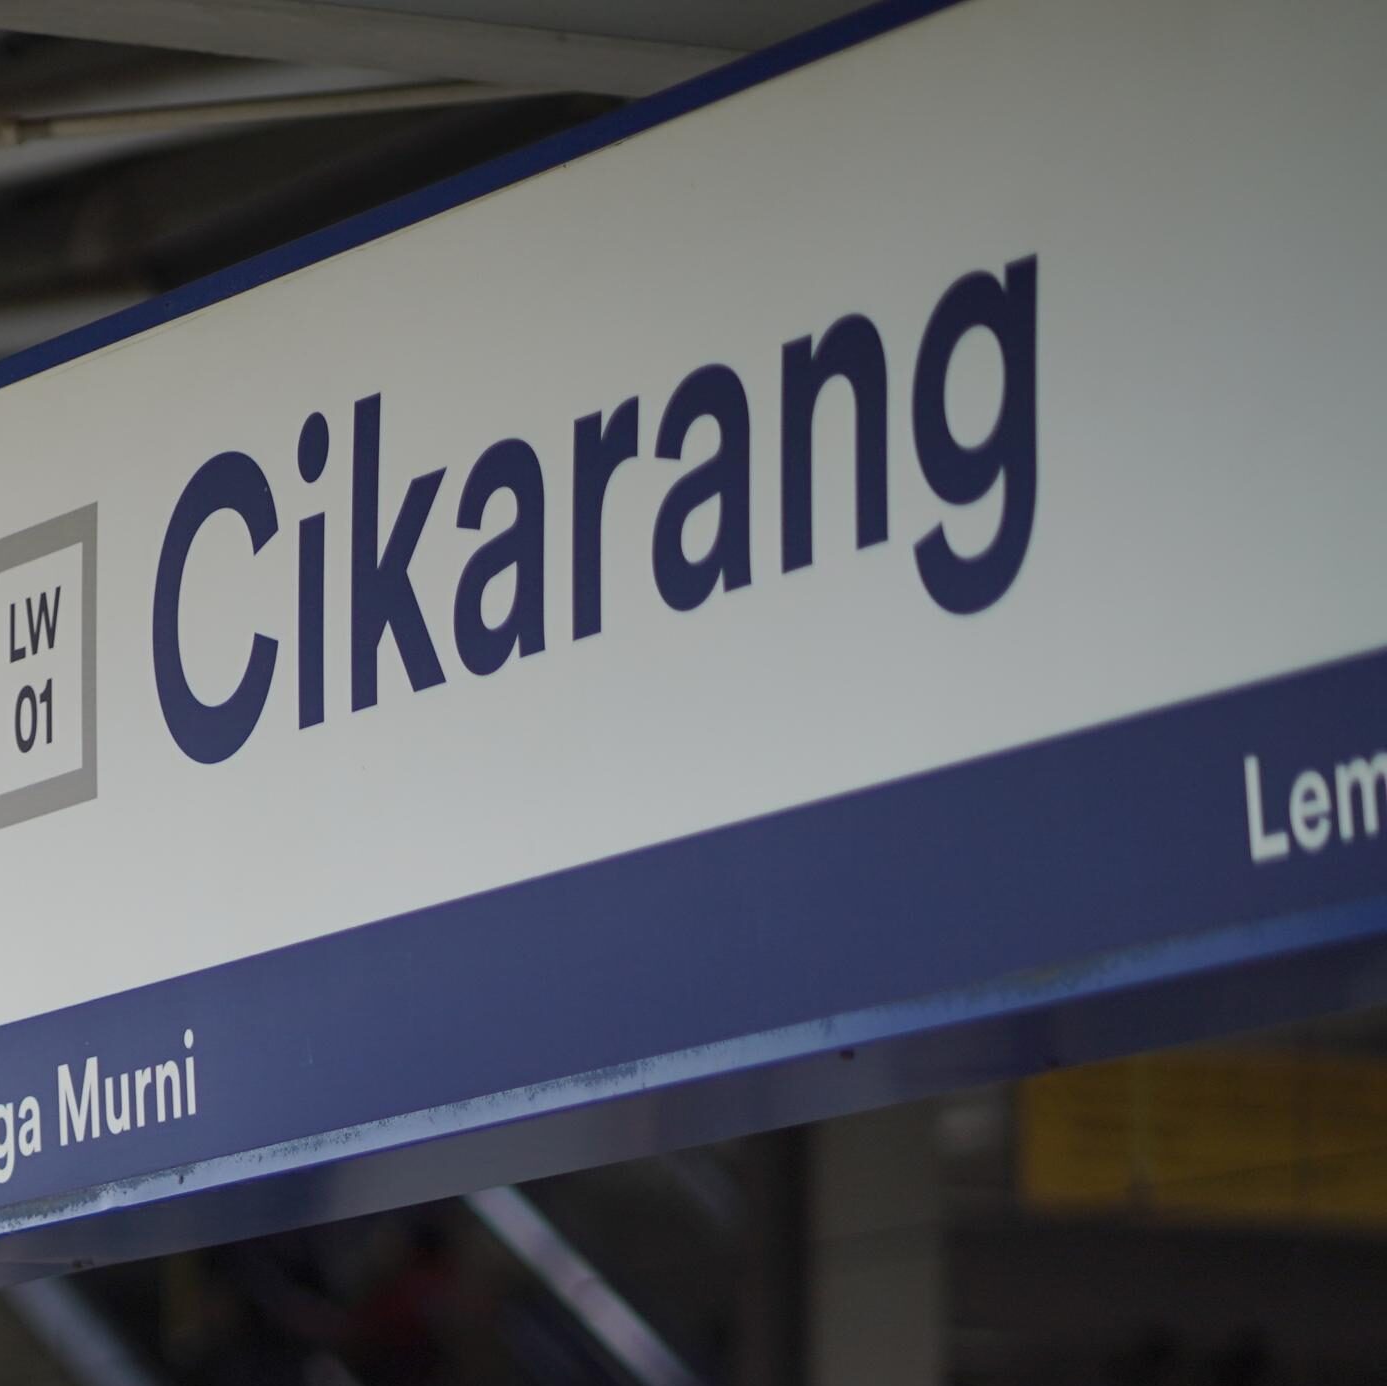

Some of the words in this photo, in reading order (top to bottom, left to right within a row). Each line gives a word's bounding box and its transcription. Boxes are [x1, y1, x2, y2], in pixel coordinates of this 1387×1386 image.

[153, 252, 1039, 765] Cikarang
[9, 586, 62, 664] LW
[14, 677, 53, 754] 01
[1244, 752, 1387, 863] Lem
[57, 1028, 198, 1147] Murni
